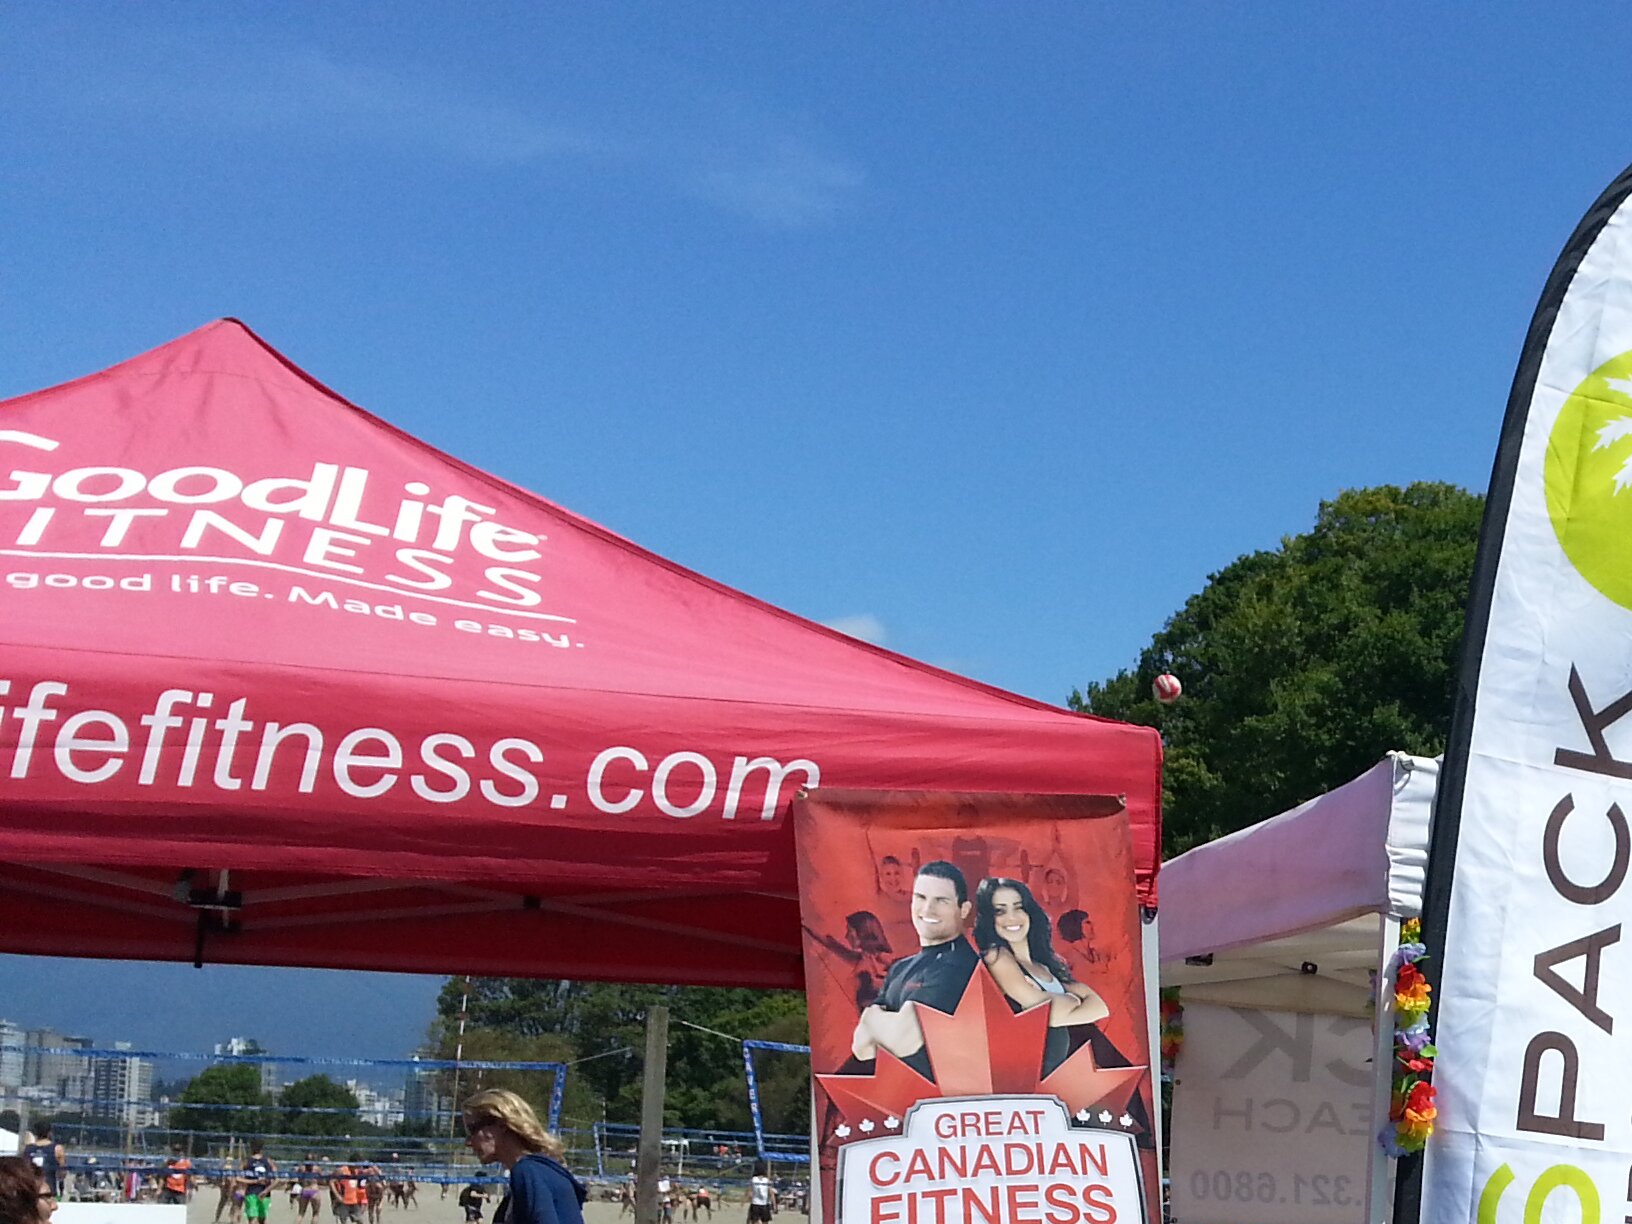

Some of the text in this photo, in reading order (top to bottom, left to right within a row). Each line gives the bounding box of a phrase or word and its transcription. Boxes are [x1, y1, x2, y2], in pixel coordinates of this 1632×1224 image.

[5, 572, 584, 648] good life. Made easy.
[0, 679, 820, 822] fefitness.com
[935, 1110, 1046, 1140] GREAT
[868, 1143, 1108, 1187] CANADIAN
